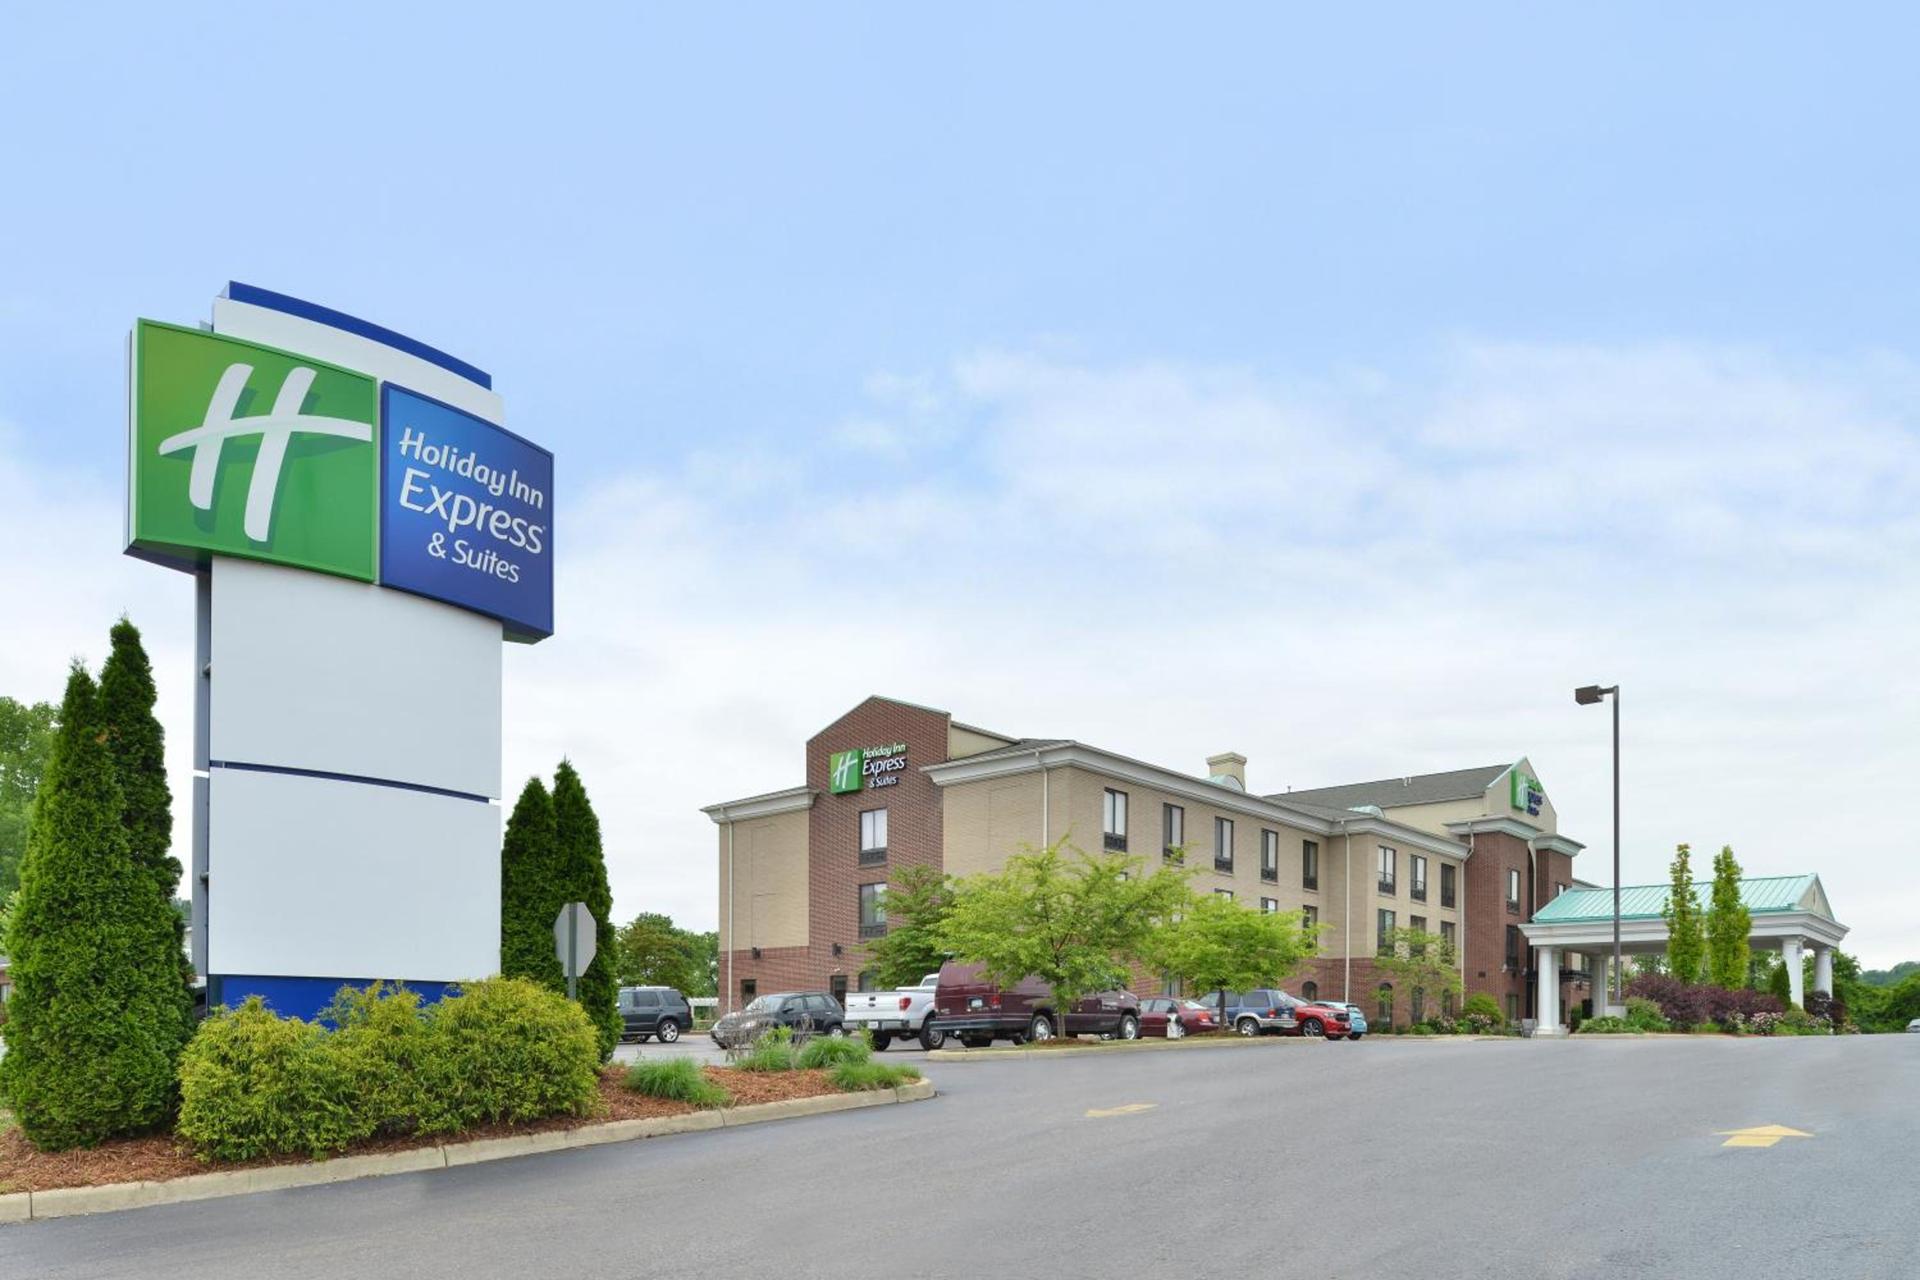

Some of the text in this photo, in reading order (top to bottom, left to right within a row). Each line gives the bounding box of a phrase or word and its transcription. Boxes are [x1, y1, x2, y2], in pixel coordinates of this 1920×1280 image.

[399, 427, 544, 510] Holiday Inn
[399, 466, 544, 554] Express
[427, 532, 521, 583] & Suites
[862, 742, 905, 759] Holiday Inn
[862, 757, 906, 777] Express
[869, 776, 897, 788] & Suites
